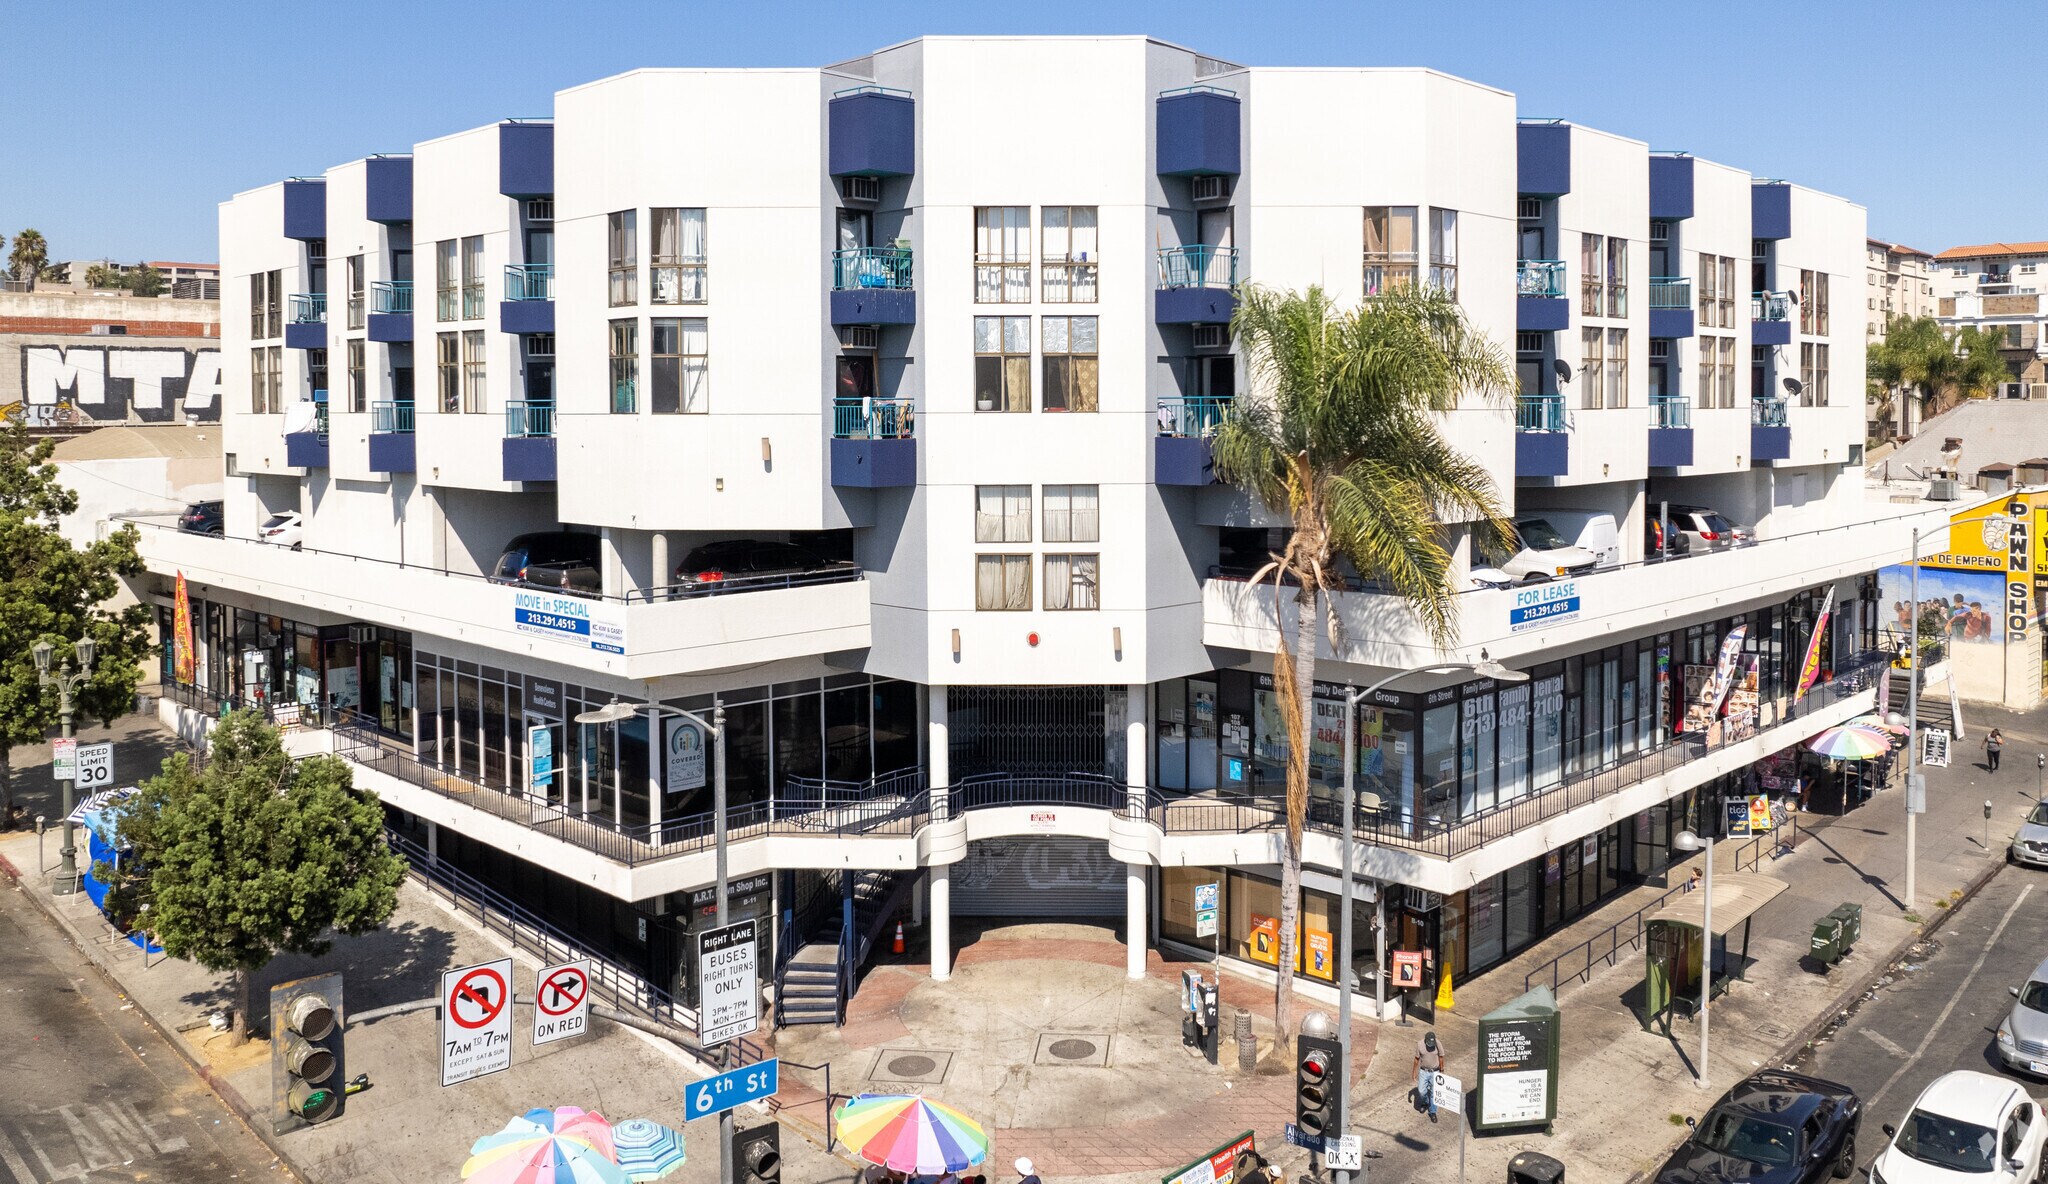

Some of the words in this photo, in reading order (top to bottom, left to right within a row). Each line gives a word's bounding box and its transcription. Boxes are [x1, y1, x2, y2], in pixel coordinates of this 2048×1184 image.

[2010, 504, 2027, 571] PAWN
[1938, 555, 1952, 564] DE
[1956, 556, 2001, 567] EMPEÑO
[1518, 590, 1539, 606] FOR
[1544, 584, 1574, 601] LEASE
[516, 593, 540, 609] MOVE
[544, 598, 550, 611] in
[554, 600, 590, 618] SPECIAL
[1524, 602, 1568, 619] 213.291.4515
[528, 613, 576, 630] 213.291.4515
[1260, 676, 1272, 686] 6th
[1312, 684, 1331, 696] amily
[1376, 692, 1400, 704] Group
[1428, 694, 1436, 704] 6th
[1438, 690, 1453, 702] Street
[1463, 685, 1478, 695] Family
[1480, 679, 1494, 690] Dental
[1464, 694, 1494, 718] 6th
[1498, 684, 1530, 708] Family
[1462, 712, 1496, 740] (213)
[80, 748, 108, 758] SPEED
[81, 757, 106, 767] LIMIT
[672, 755, 700, 764] COVERED
[82, 766, 107, 782] 30
[694, 890, 714, 904] A.R.T.
[736, 881, 753, 892] Shop
[756, 878, 768, 887] Inc.
[704, 934, 728, 948] RIGHT
[731, 928, 752, 941] LANE
[710, 948, 747, 968] BUSES
[704, 969, 726, 983] RIGHT
[730, 961, 754, 975] TURNS
[715, 977, 743, 994] ONLY
[712, 1000, 748, 1017] 3PM-7PM
[713, 1010, 747, 1027] MON-FRI
[538, 1022, 554, 1037] ON
[559, 1016, 582, 1032] RED
[712, 1026, 734, 1040] BIKES
[738, 1023, 748, 1032] OK
[447, 1041, 472, 1057] 7AM
[474, 1037, 482, 1046] TO
[484, 1031, 508, 1047] 7PM
[447, 1071, 467, 1081] TRANSIT
[488, 1060, 507, 1069] EXEMPT
[450, 1057, 472, 1068] EXCEPT
[696, 1077, 733, 1112] 6th
[746, 1070, 767, 1093] St
[1214, 1150, 1231, 1166] Health
[1232, 1147, 1236, 1156] &
[1328, 1152, 1340, 1164] OK
